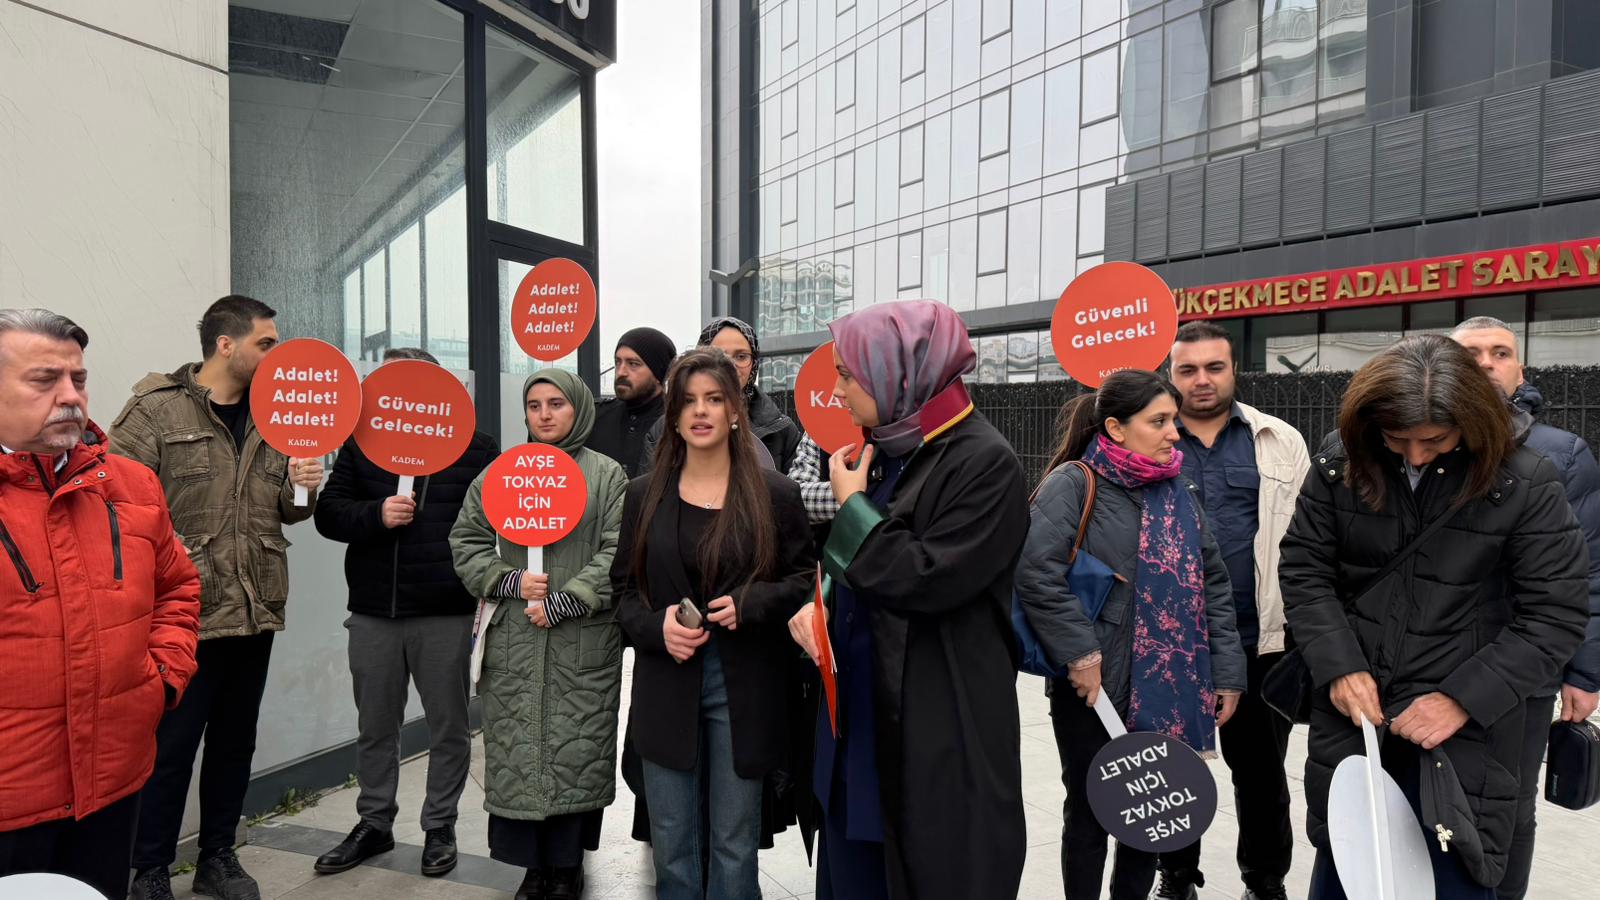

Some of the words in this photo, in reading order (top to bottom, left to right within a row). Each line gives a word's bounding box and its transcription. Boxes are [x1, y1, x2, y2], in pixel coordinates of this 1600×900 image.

[530, 283, 580, 296] Adalet!
[1173, 276, 1329, 315] ÜKÇEKMECE
[1334, 260, 1465, 300] ADALET
[528, 302, 578, 315] Adalet!
[1074, 297, 1149, 325] Güvenli
[524, 321, 575, 334] Adalet!
[1071, 321, 1156, 349] Gelecek!
[537, 343, 560, 352] KADEM
[273, 366, 338, 383] Adalet!
[272, 389, 338, 405] Adalet!
[377, 395, 451, 417] Güvenli
[269, 411, 335, 427] Adalet!
[370, 416, 454, 438] Gelecek!
[288, 438, 318, 448] KADEM
[391, 455, 425, 466] KADEM
[514, 455, 555, 470] AYŞE
[502, 475, 567, 489] TOKYAZ
[518, 492, 551, 512] İÇİN
[502, 516, 567, 530] ADALET
[1099, 741, 1168, 781] ADALET
[1125, 771, 1169, 796] İÇİN
[1120, 787, 1197, 825] TOKYAZ
[1145, 814, 1191, 842] AYŞE
